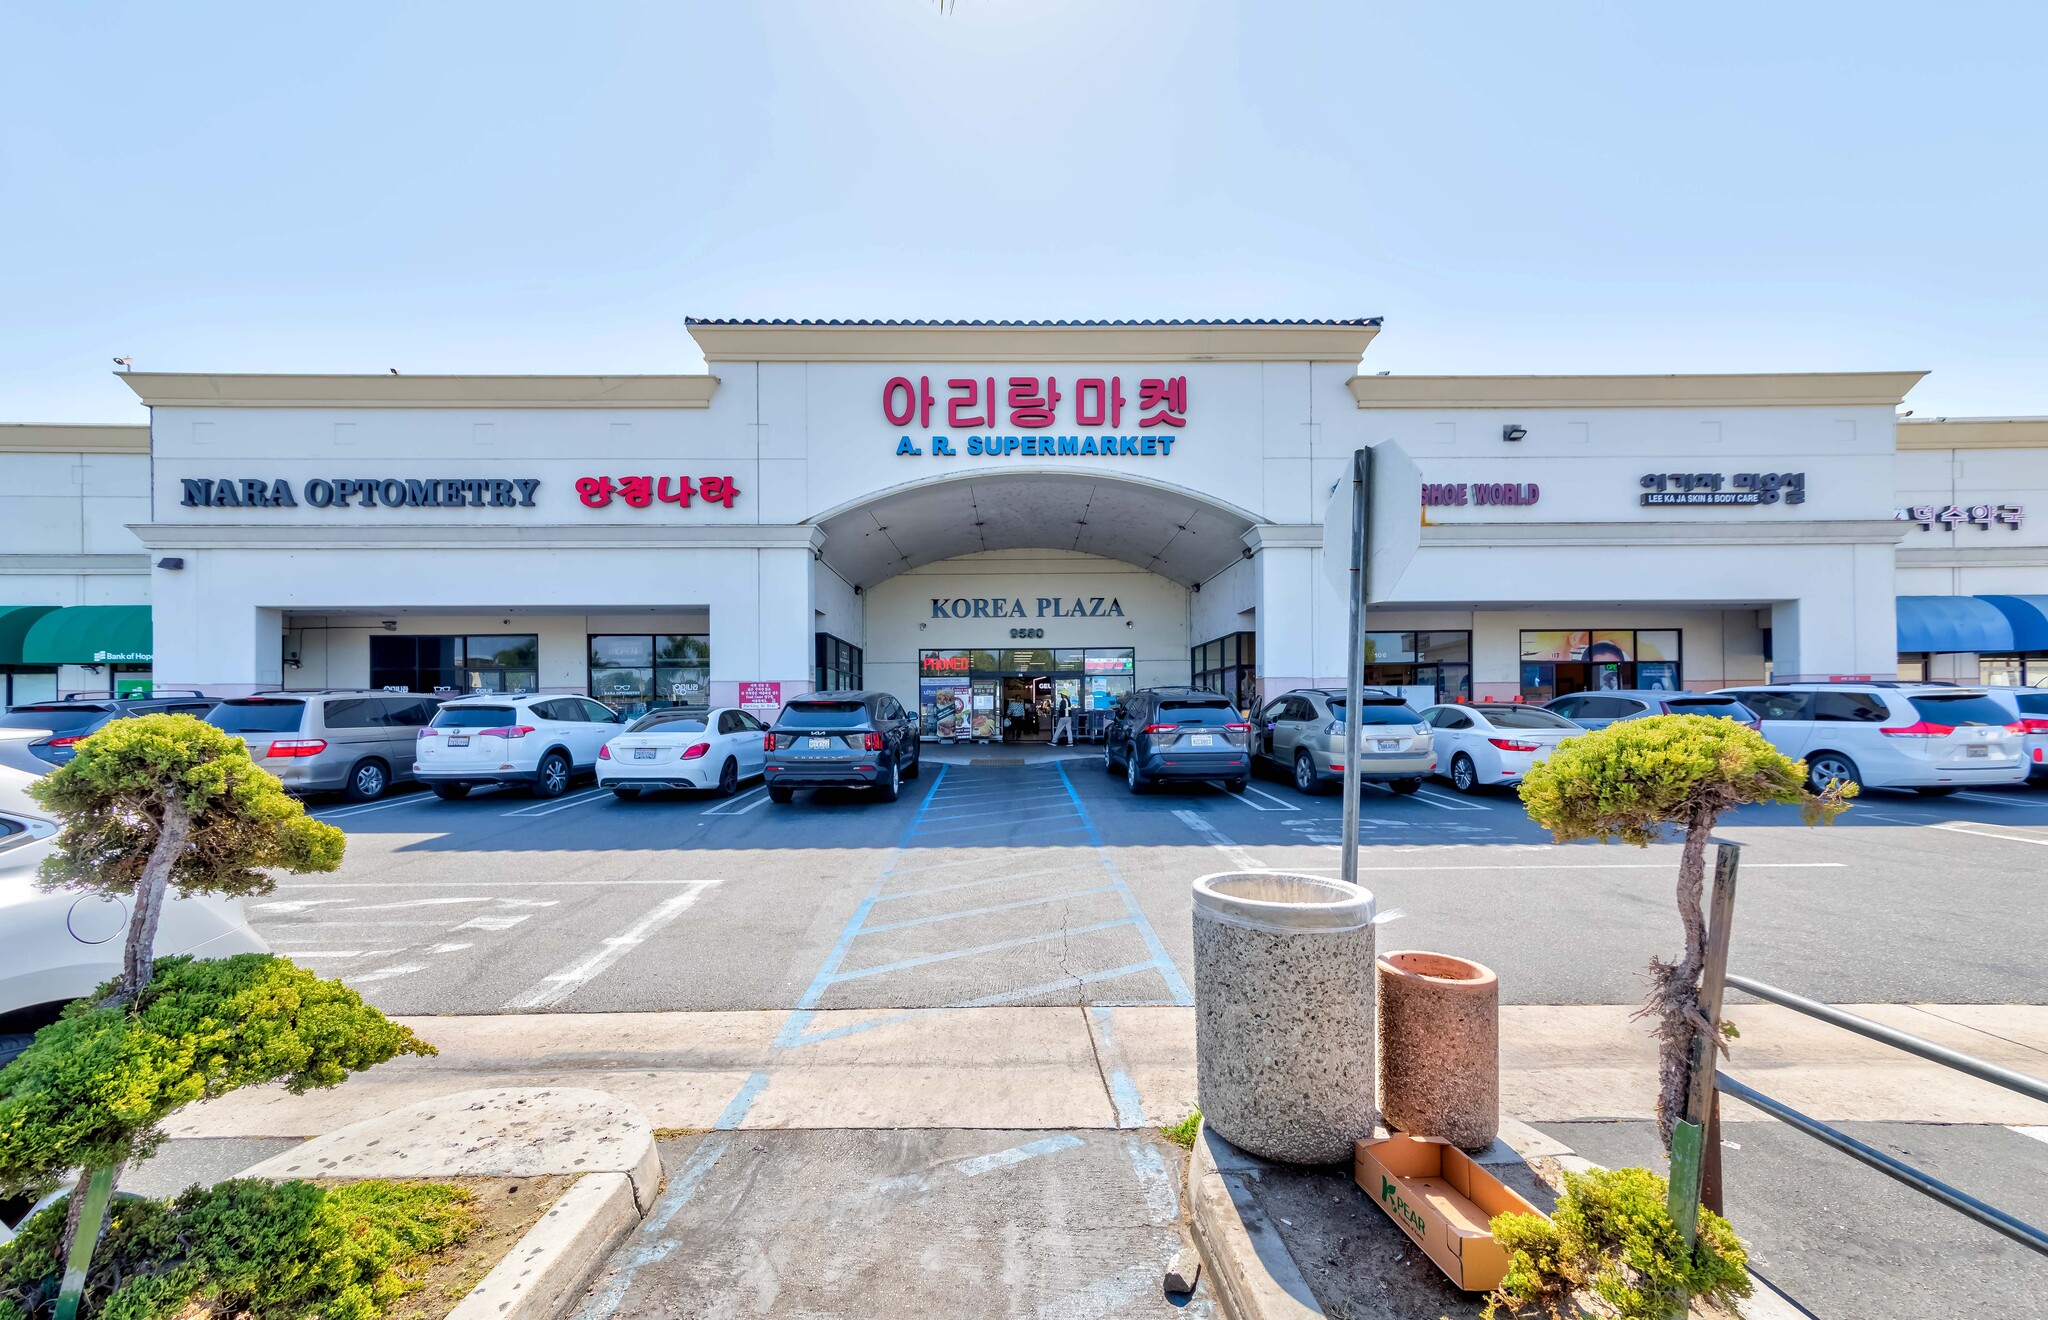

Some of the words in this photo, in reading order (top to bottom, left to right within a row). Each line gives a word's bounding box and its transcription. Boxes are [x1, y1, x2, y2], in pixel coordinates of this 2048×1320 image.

[882, 375, 1188, 428] 아리랑마켓
[896, 435, 922, 456] A.
[932, 436, 956, 456] R.
[967, 435, 1176, 456] SUPERMARKET
[180, 478, 299, 508] NARA
[303, 478, 541, 509] OPTOMETRY
[575, 475, 742, 509] 안경나라
[1421, 483, 1468, 506] SHOE
[1474, 483, 1541, 506] WORLD
[1640, 473, 1725, 492] 이가자
[1733, 472, 1806, 505] 미용실
[1648, 494, 1663, 503] LEE
[1664, 494, 1675, 503] KA
[1676, 494, 1687, 503] JA
[1687, 494, 1706, 503] SKIN
[1707, 494, 1713, 503] &
[1715, 494, 1736, 503] BODY
[1737, 493, 1759, 502] CARE
[1910, 503, 2026, 531] 덕수약국
[931, 598, 1027, 619] KOREA
[1036, 597, 1125, 618] PLAZA
[106, 652, 126, 660] Bank
[126, 652, 135, 660] of
[1606, 663, 1617, 671] OPE
[1397, 1196, 1426, 1236] PEAR
